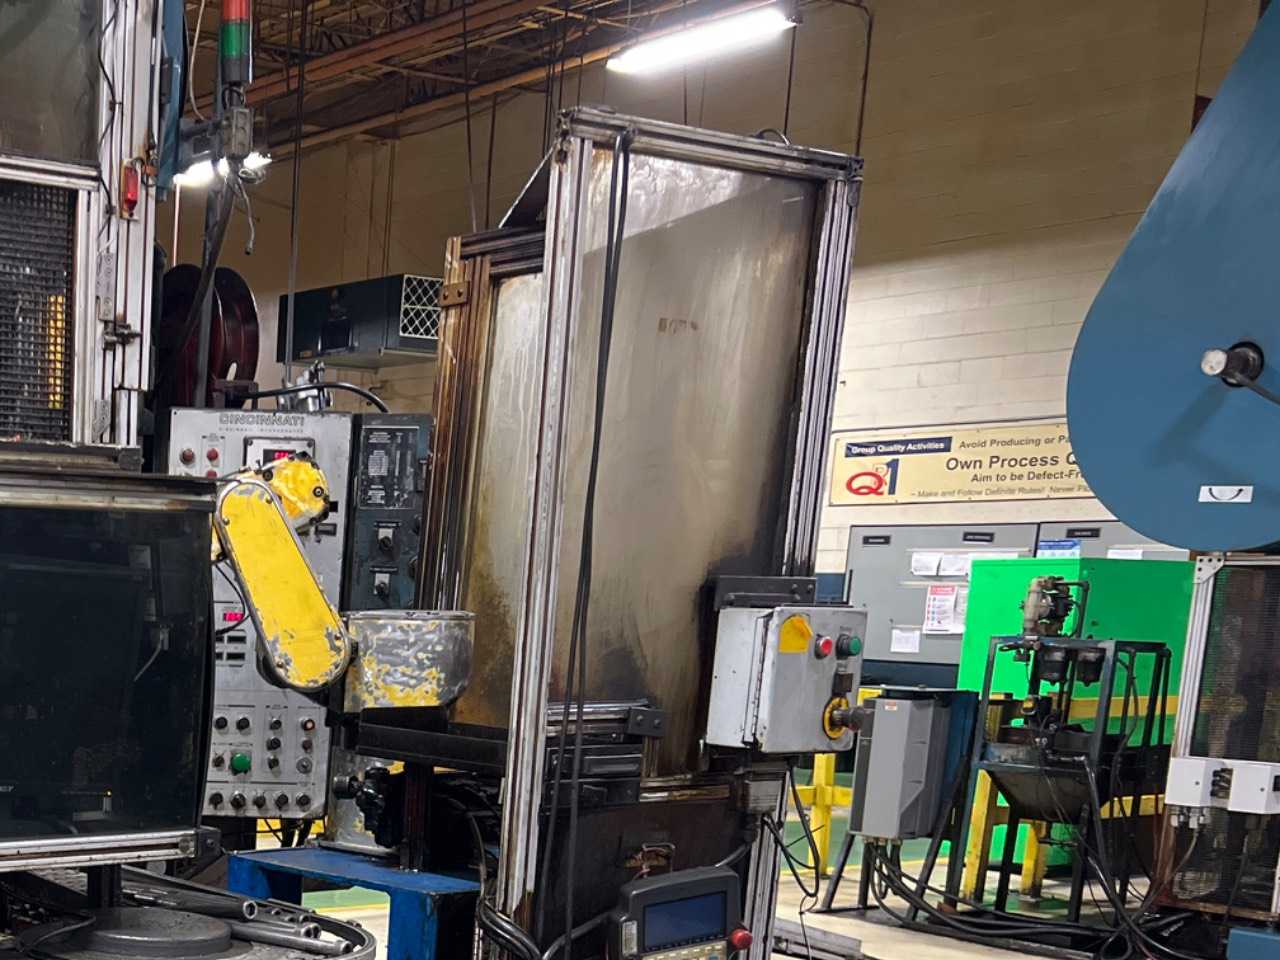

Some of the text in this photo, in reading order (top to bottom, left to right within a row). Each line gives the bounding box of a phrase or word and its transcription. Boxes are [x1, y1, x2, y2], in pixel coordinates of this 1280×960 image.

[219, 413, 305, 426] CINCINNATI
[850, 441, 945, 454] Group Quality Activities
[959, 440, 987, 449] Avoid
[989, 437, 1041, 448] Producing
[1044, 437, 1055, 445] or
[946, 457, 983, 471] Own
[988, 454, 1060, 469] Process
[971, 473, 992, 482] Aim
[996, 473, 1007, 482] to
[1010, 472, 1024, 481] be
